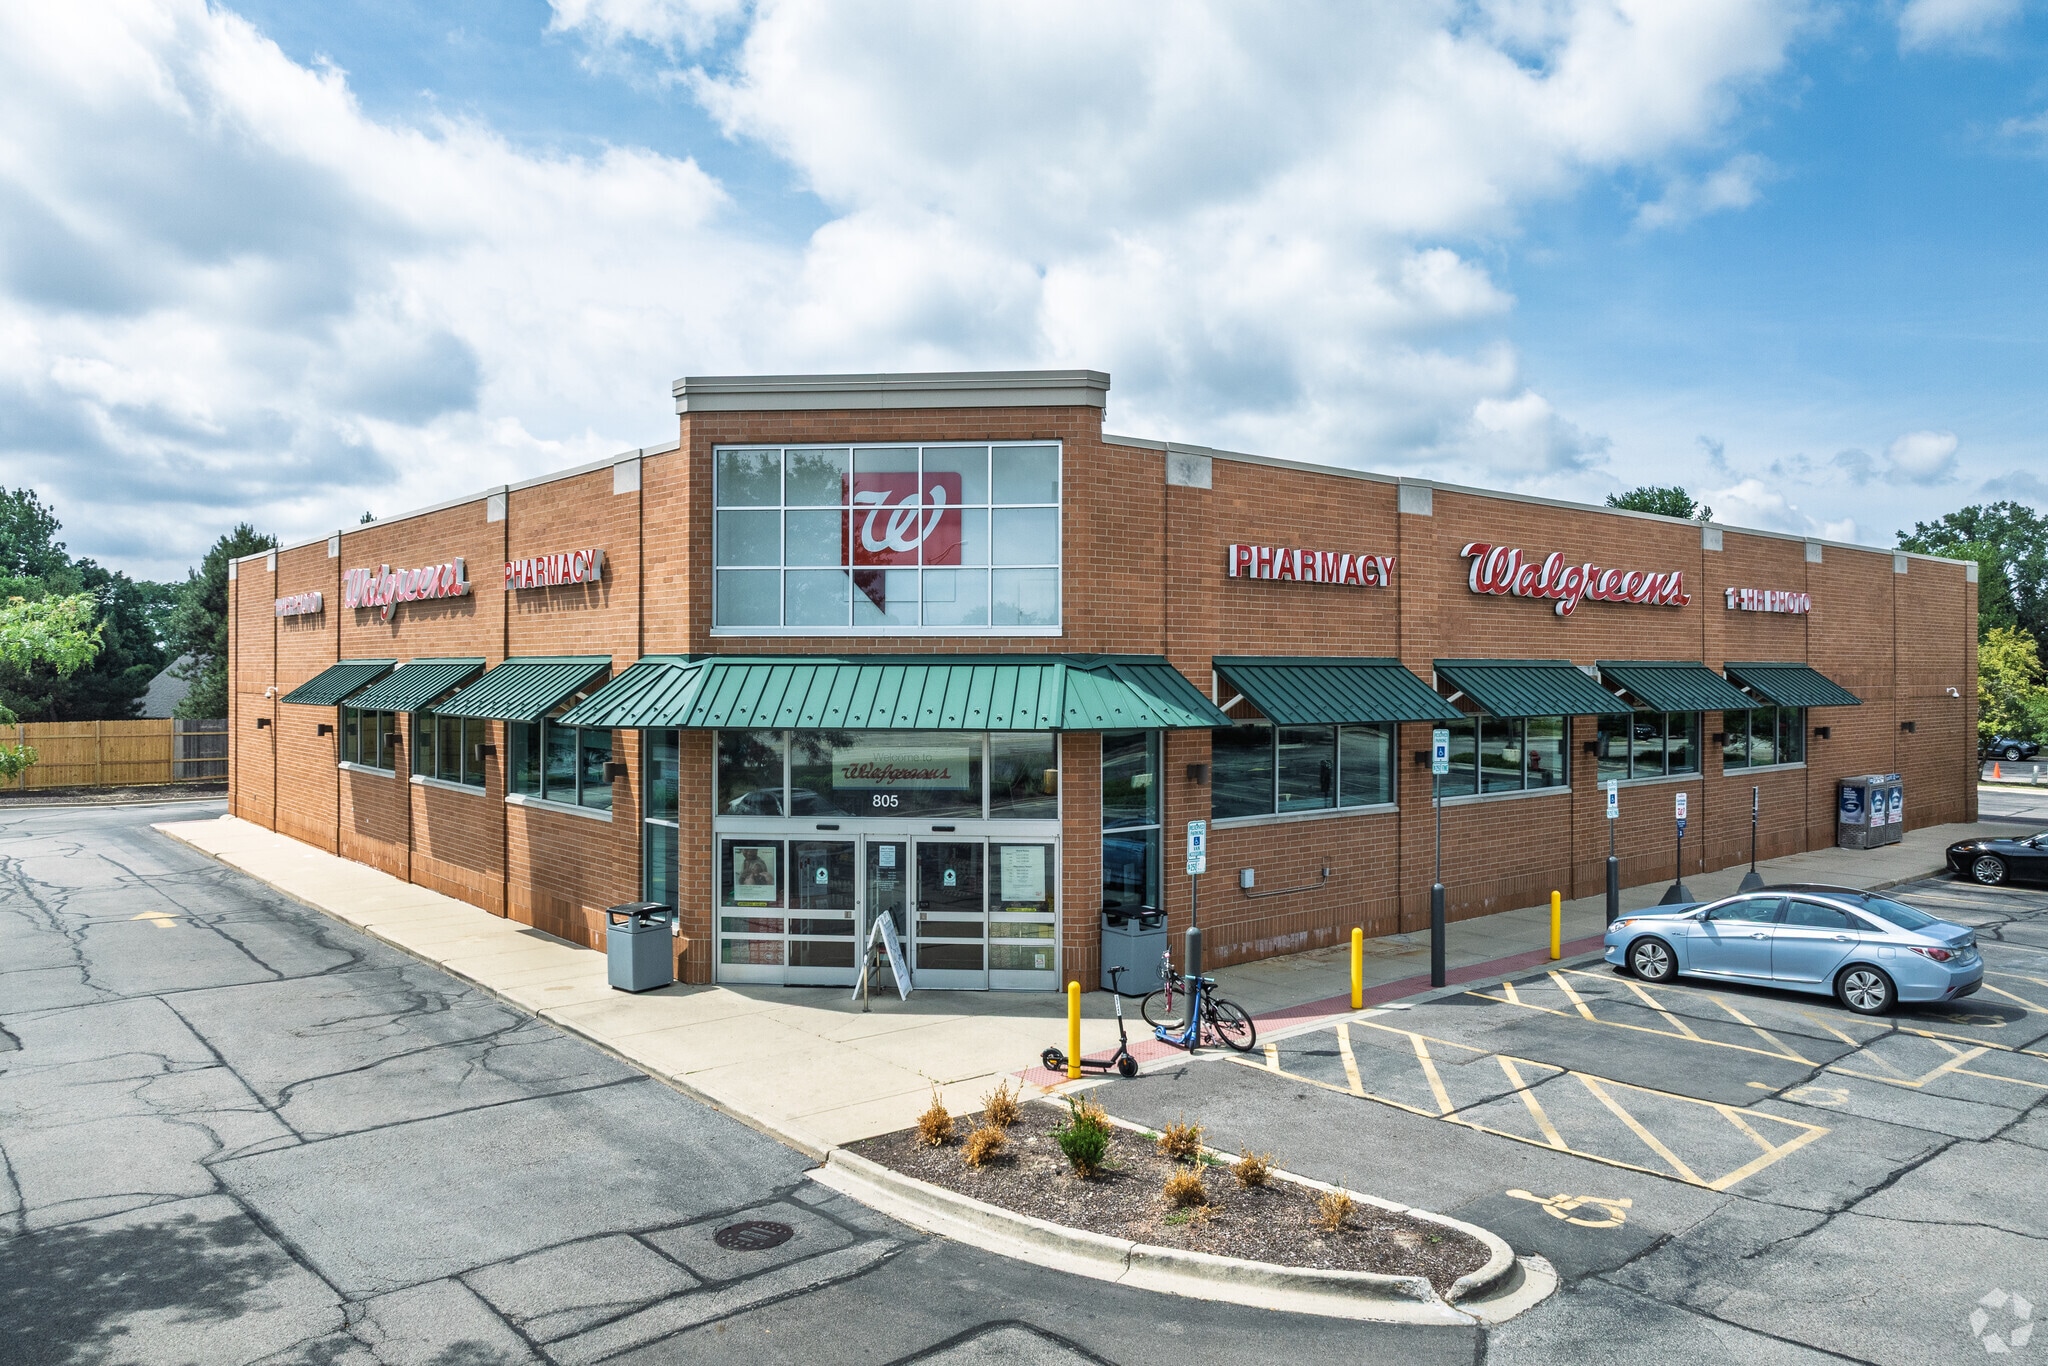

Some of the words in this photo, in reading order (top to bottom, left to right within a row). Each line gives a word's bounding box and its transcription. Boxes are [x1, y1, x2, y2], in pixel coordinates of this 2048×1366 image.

[504, 549, 602, 590] PHARMACY
[1231, 544, 1397, 587] PHARMACY
[1461, 542, 1691, 616] Walgreens
[343, 557, 469, 620] Walgreens
[1765, 591, 1811, 614] PHOTO
[873, 753, 919, 761] Welcome
[922, 753, 933, 761] to
[872, 794, 899, 807] 805
